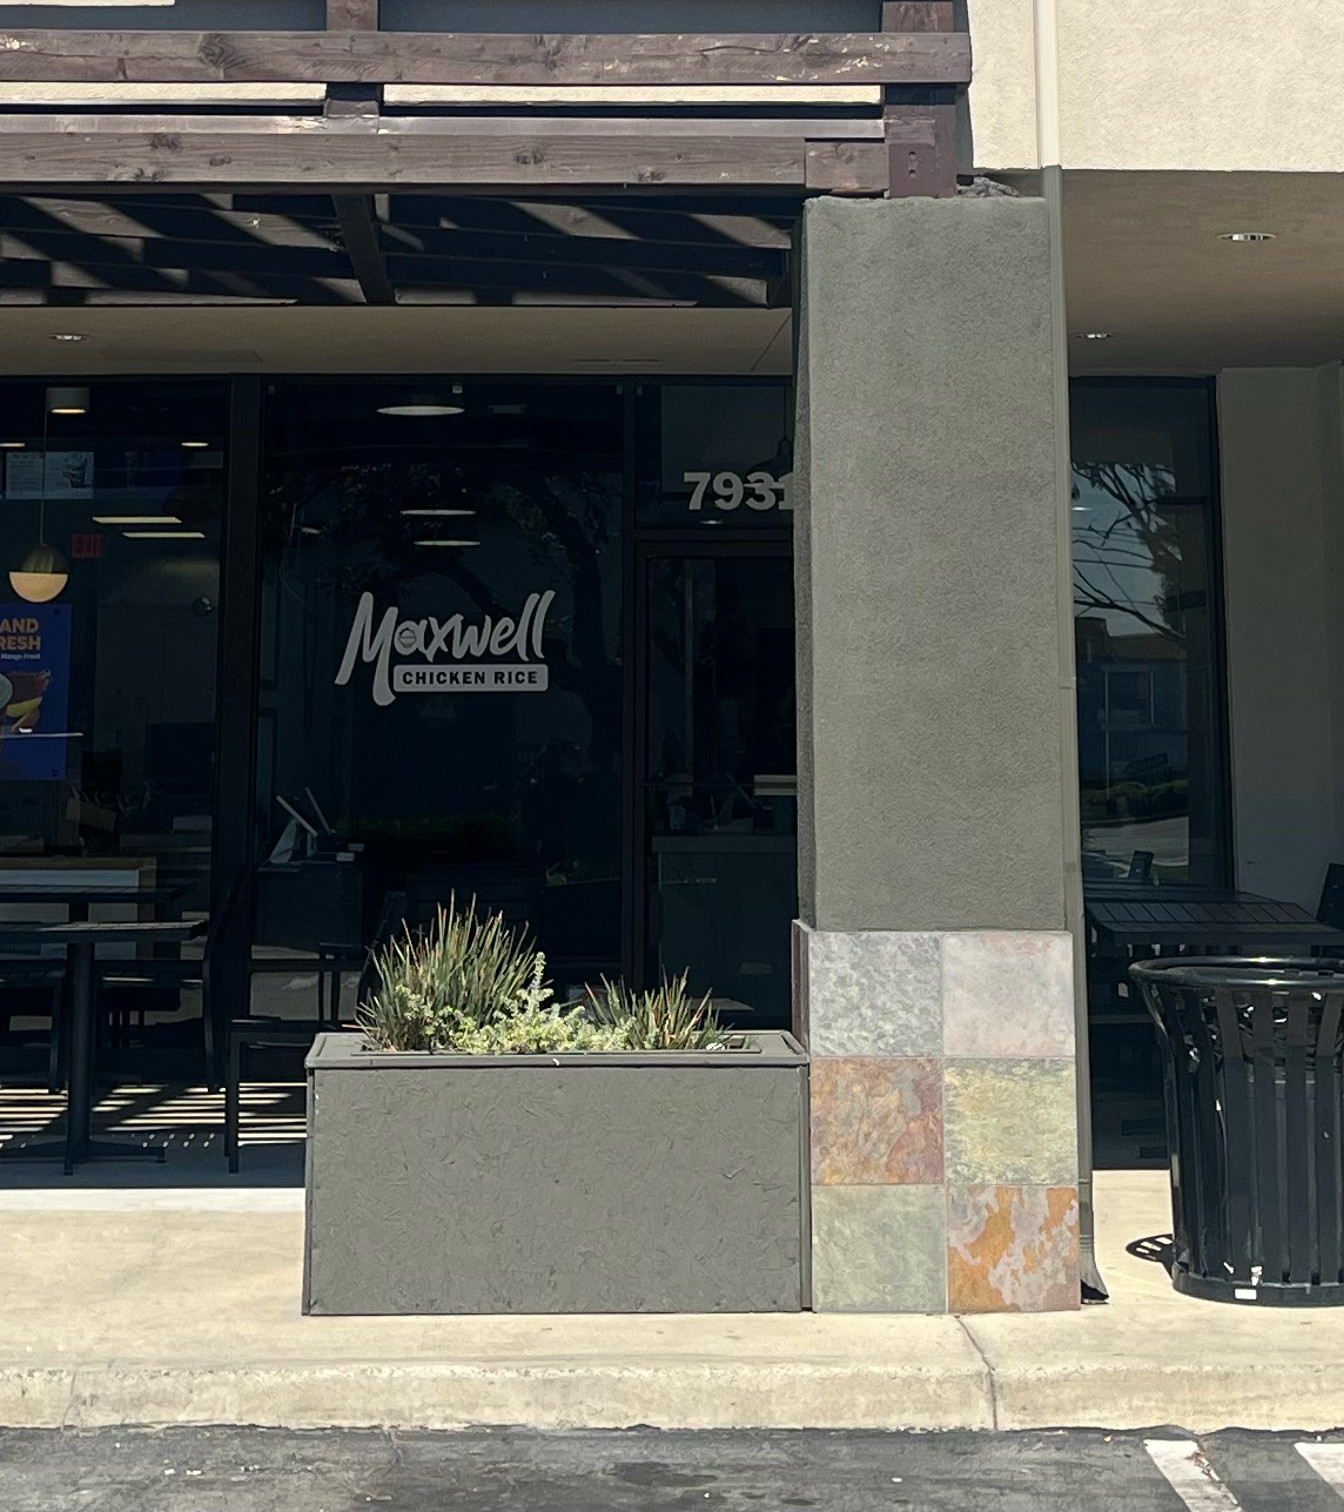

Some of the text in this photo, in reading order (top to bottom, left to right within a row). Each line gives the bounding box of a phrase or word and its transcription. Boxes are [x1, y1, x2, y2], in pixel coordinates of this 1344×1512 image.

[334, 589, 557, 707] Maxwell
[402, 671, 538, 685] CHICKEN RICE
